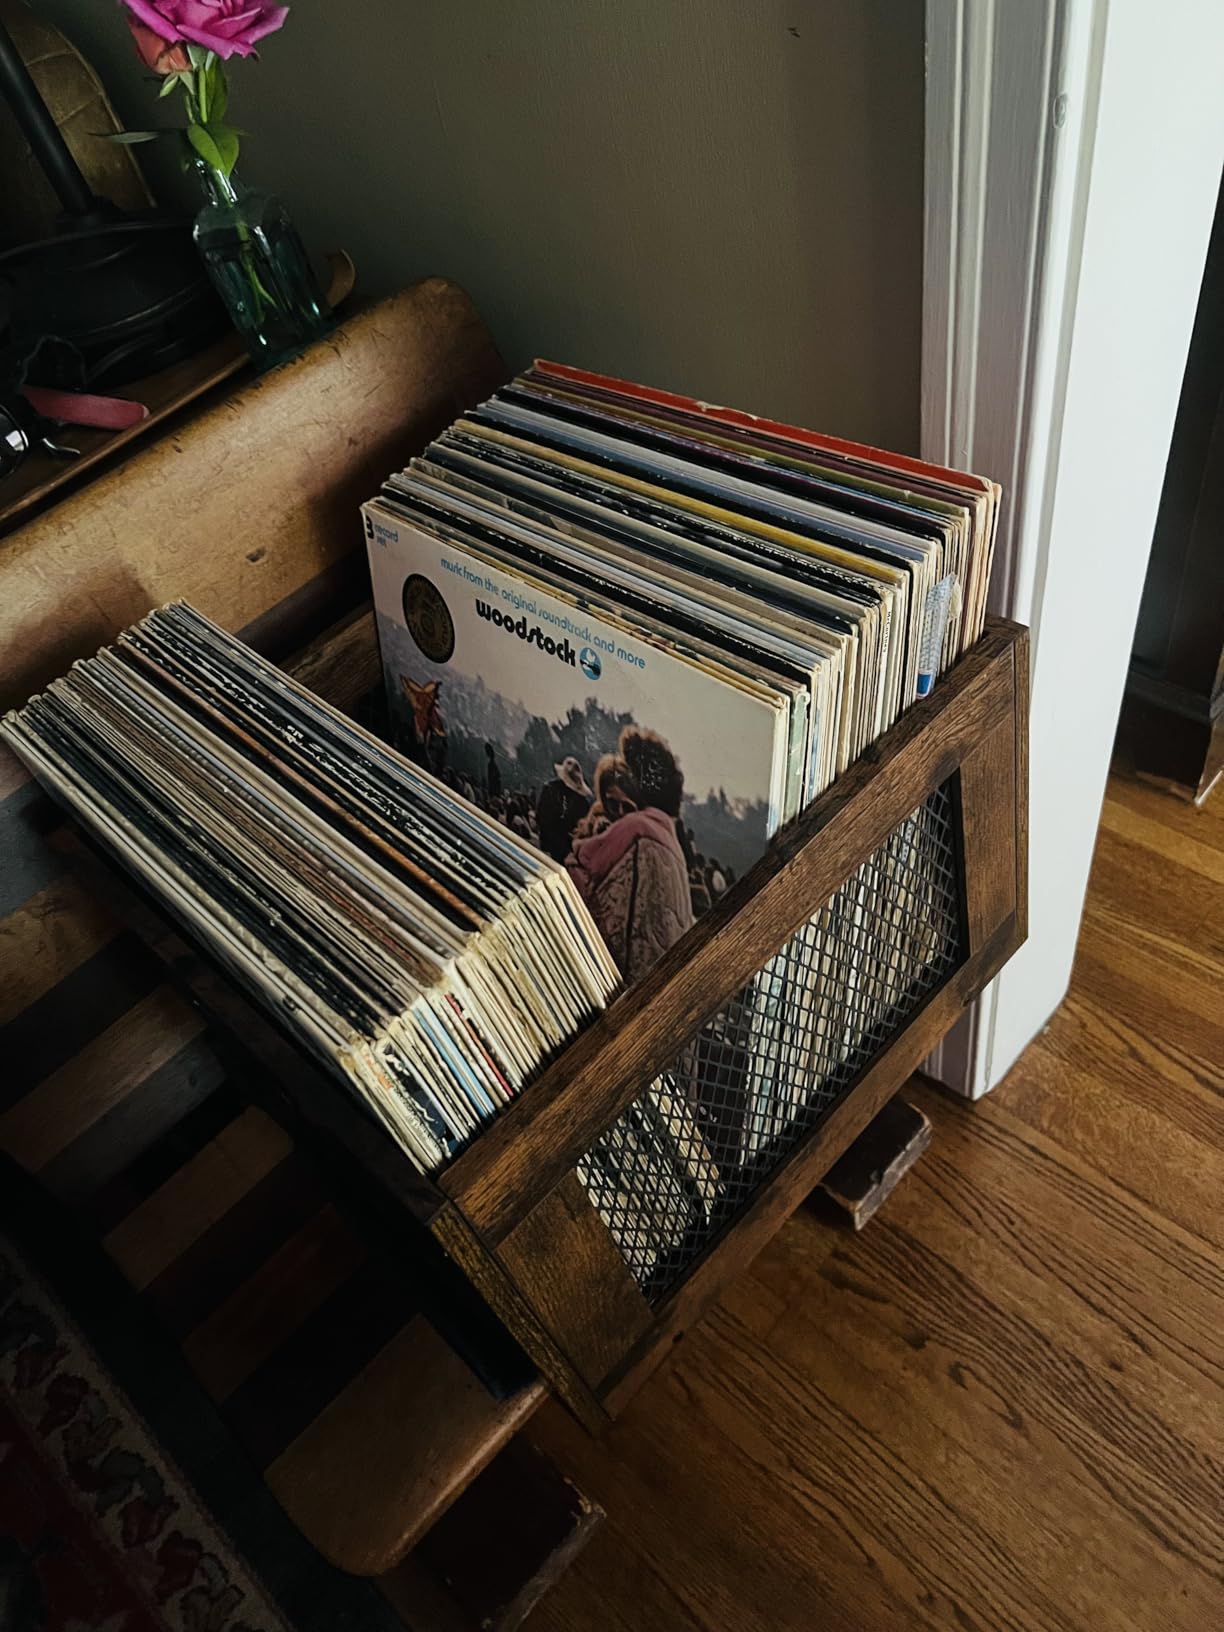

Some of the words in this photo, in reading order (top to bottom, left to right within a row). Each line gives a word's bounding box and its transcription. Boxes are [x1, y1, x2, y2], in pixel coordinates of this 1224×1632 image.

[366, 515, 374, 539] 3
[374, 523, 399, 543] record
[440, 557, 463, 577] music
[463, 566, 484, 588] from
[485, 578, 500, 596] the
[501, 589, 537, 615] original
[538, 606, 592, 643] soundtrack
[593, 634, 616, 654] and
[616, 647, 646, 669] more
[475, 598, 576, 668] woodstock
